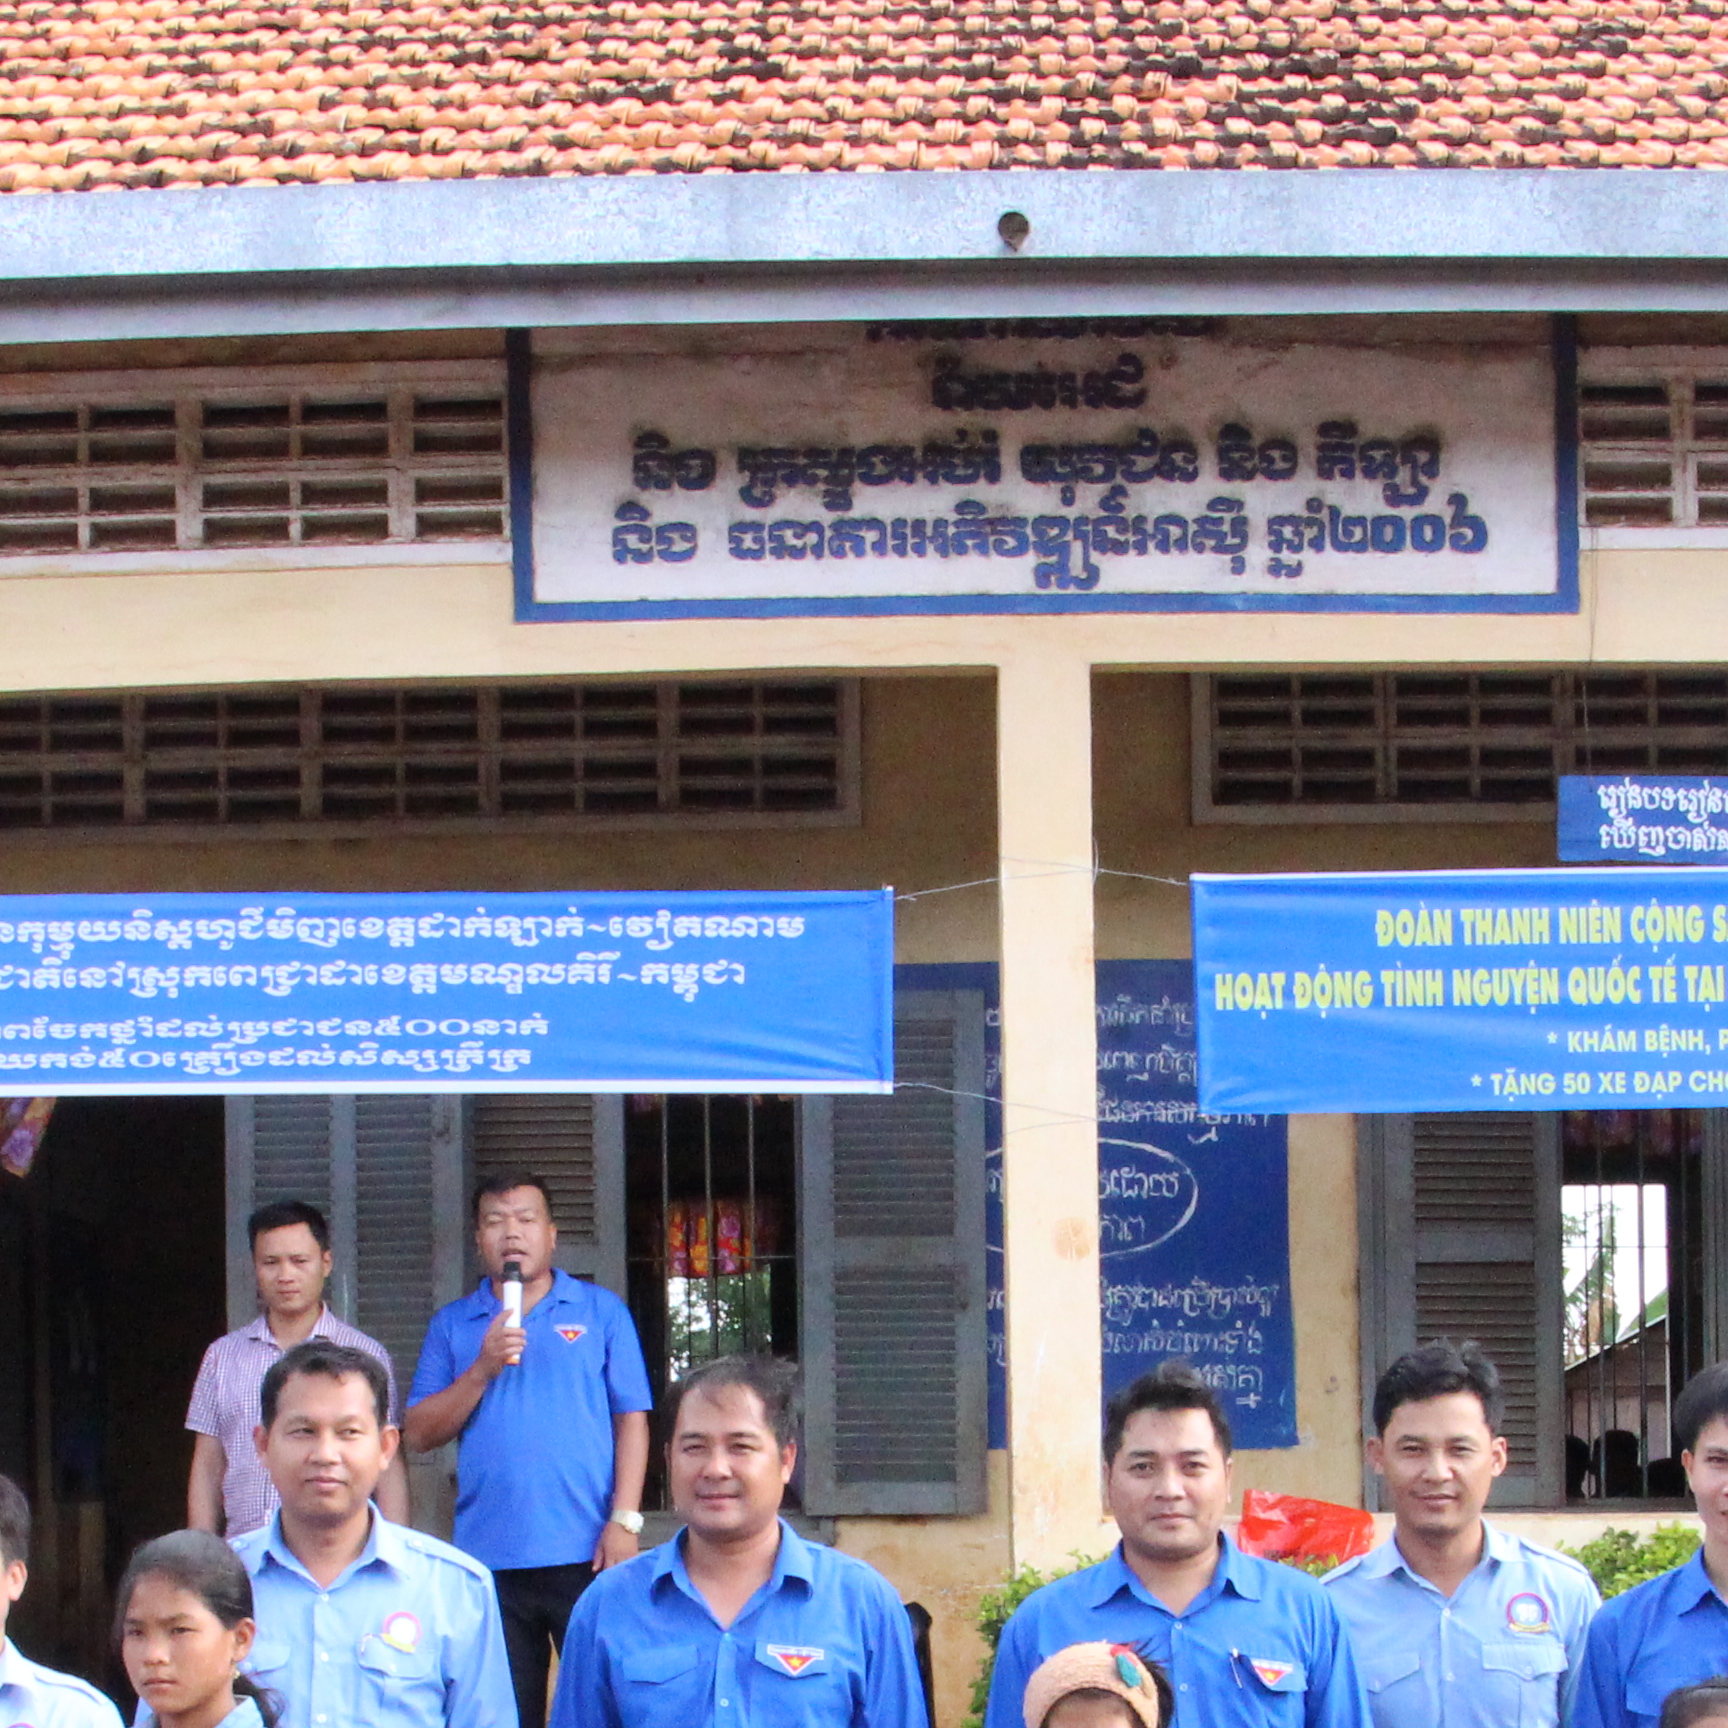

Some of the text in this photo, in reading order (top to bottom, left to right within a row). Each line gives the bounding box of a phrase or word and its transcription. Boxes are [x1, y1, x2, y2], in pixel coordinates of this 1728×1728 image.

[611, 500, 698, 565] និង
[1374, 900, 1453, 947] ĐOÀN
[1459, 906, 1551, 946] THANH
[1558, 898, 1623, 944] NIÊN
[1629, 897, 1706, 952] CỘNG
[1214, 970, 1286, 1020] HOẠT
[1292, 963, 1374, 1019] ĐỘNG
[1380, 961, 1444, 1007] TÌNH
[1452, 959, 1561, 1015] NGUYỆN
[1567, 954, 1643, 1006] QUỐC
[1648, 956, 1678, 1003] TẾ
[1683, 964, 1727, 1012] TẠI
[1567, 1023, 1638, 1053] KHÁM
[1643, 1023, 1712, 1058] BỆNH,
[1489, 1067, 1557, 1102] TẶNG
[1562, 1071, 1592, 1095] 50
[1597, 1070, 1627, 1094] XE
[1632, 1070, 1683, 1100] ĐẠP
